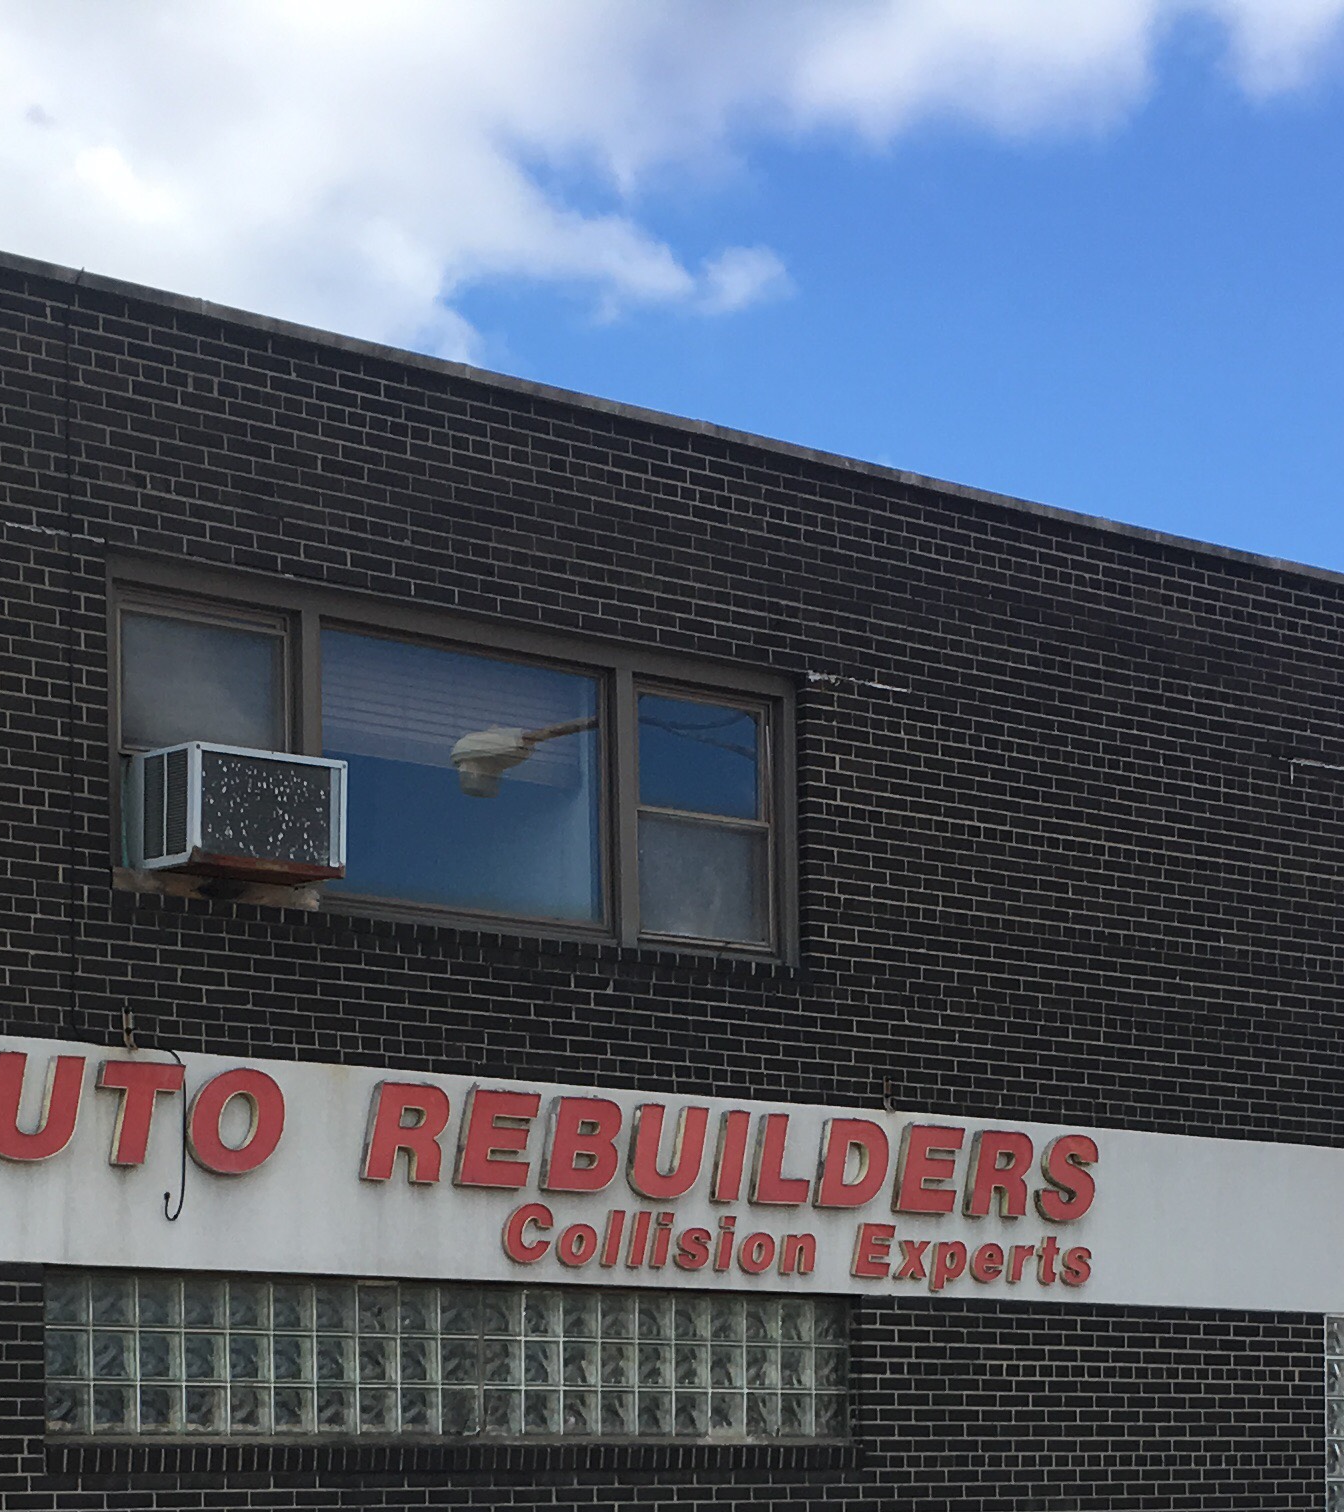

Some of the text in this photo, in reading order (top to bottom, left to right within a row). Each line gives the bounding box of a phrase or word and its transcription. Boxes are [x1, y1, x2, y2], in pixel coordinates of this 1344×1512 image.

[360, 1080, 1100, 1223] REBUILDERS
[503, 1202, 1094, 1292] Collision Experts
